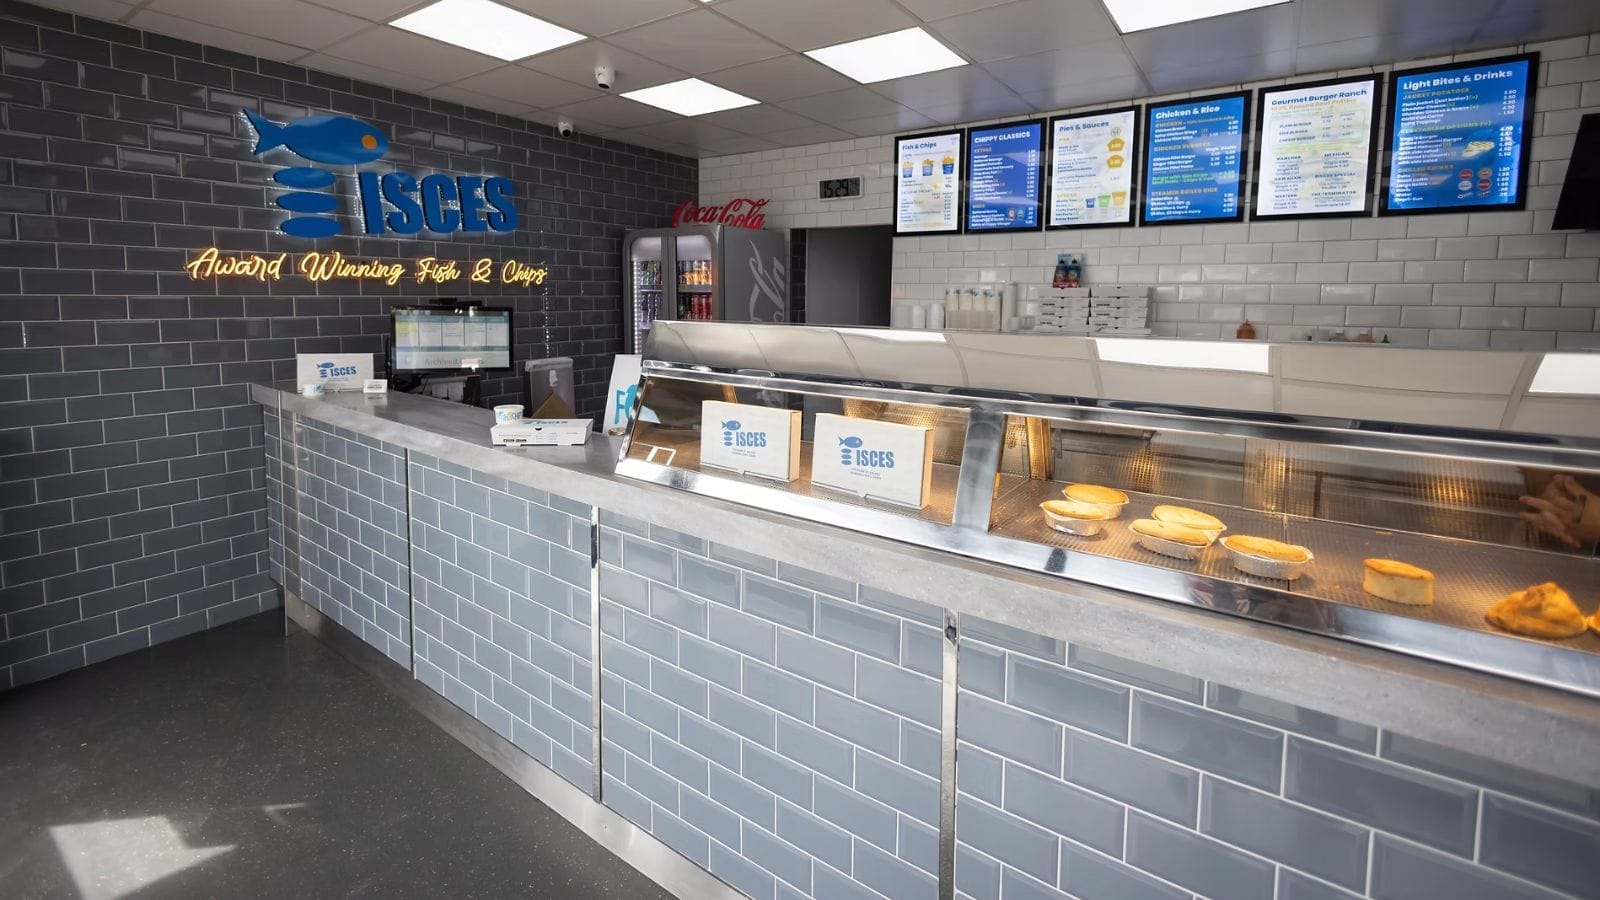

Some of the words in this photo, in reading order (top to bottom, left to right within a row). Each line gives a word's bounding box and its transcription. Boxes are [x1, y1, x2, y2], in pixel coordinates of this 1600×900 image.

[1403, 80, 1431, 92] Light
[1433, 77, 1461, 86] Bites
[1463, 75, 1472, 83] &
[1474, 70, 1513, 81] Drinks
[1272, 97, 1307, 106] Gourmet
[1309, 94, 1337, 103] Burger
[1339, 90, 1367, 98] Ranch
[1155, 109, 1191, 120] Chicken
[1200, 105, 1220, 114] Rice
[920, 141, 937, 149] Chips
[974, 136, 997, 144] CHIPPY
[999, 132, 1030, 141] CLASSICS
[357, 171, 518, 235] ISCES
[672, 198, 769, 231] Coca-Cola
[183, 247, 287, 281] Award
[300, 252, 405, 285] Winning
[417, 257, 461, 282] Fish
[471, 258, 492, 282] &
[502, 260, 547, 286] Chips
[330, 366, 357, 377] ISCES
[736, 431, 767, 447] ISCES
[856, 449, 895, 468] ISCES
